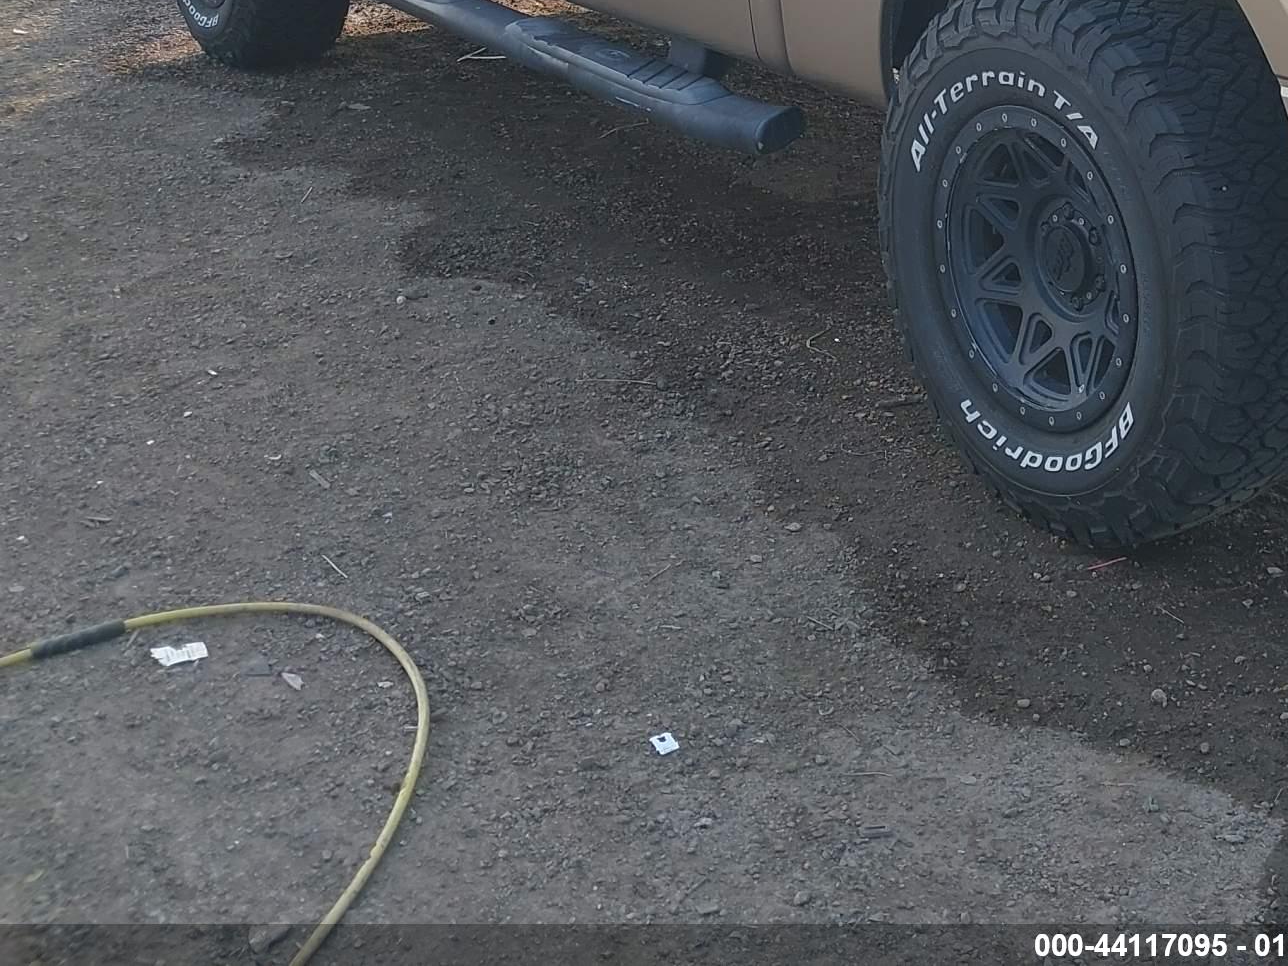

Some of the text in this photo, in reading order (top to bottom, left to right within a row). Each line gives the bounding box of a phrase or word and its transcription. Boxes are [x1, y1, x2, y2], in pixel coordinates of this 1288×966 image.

[910, 70, 1100, 172] All-Terrain T/A
[960, 399, 1135, 472] BFGoodrich
